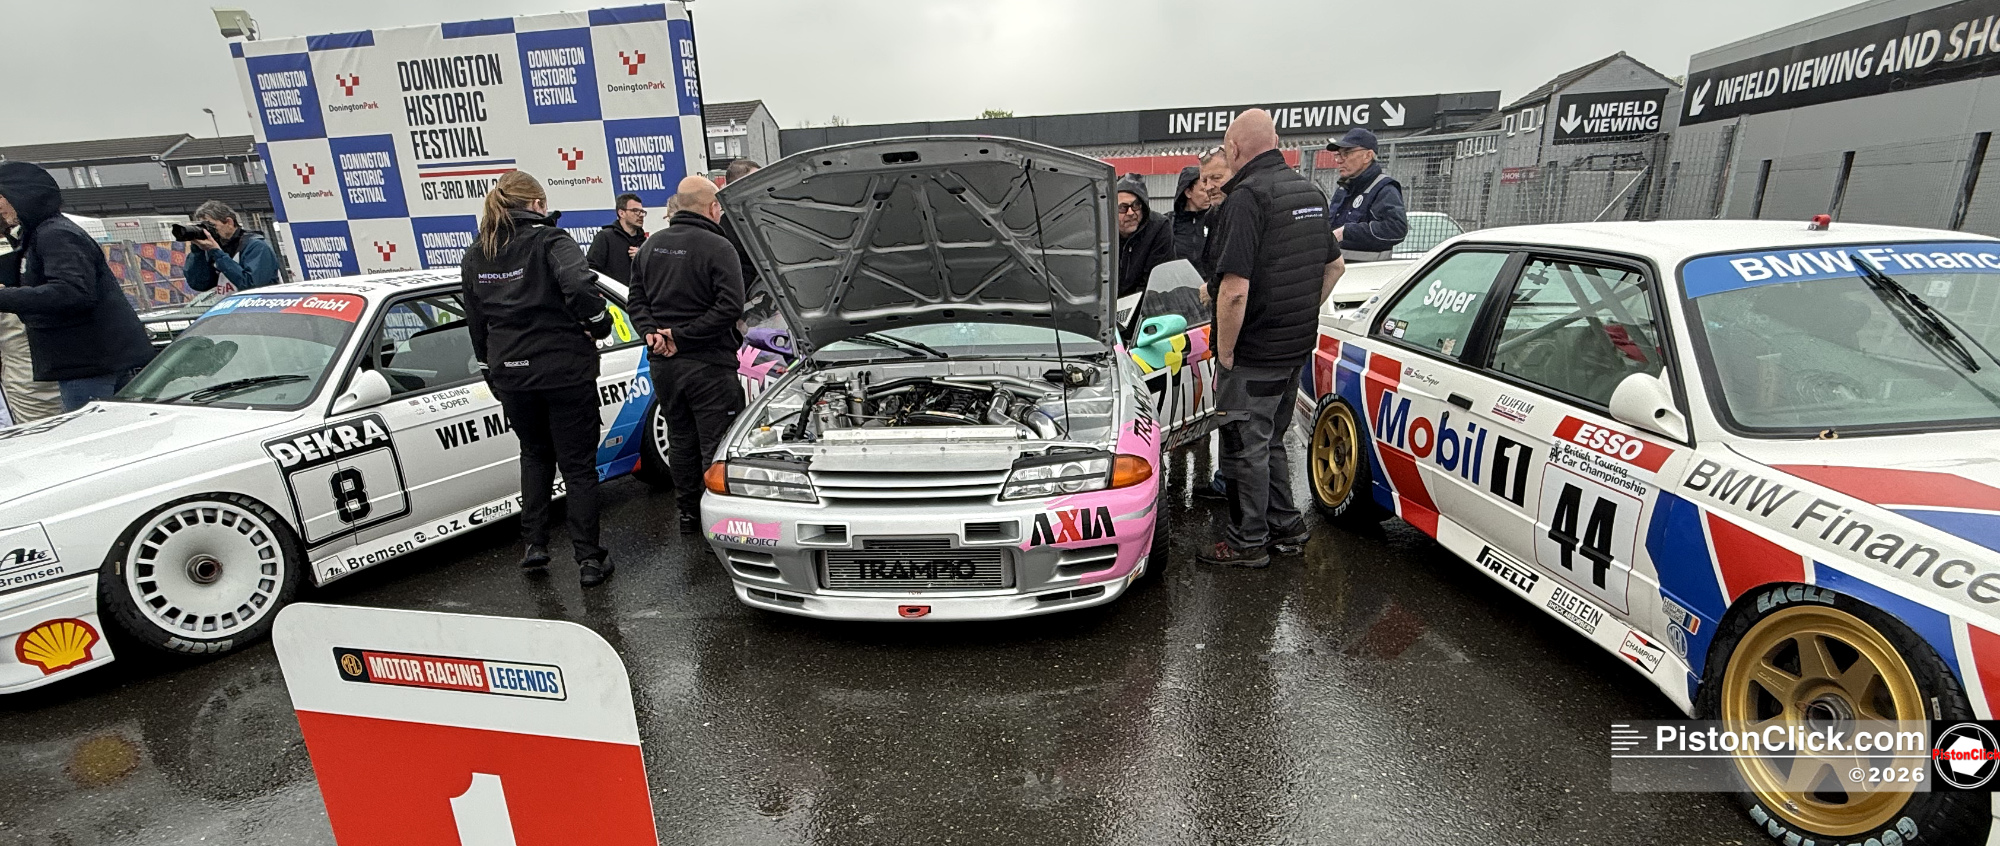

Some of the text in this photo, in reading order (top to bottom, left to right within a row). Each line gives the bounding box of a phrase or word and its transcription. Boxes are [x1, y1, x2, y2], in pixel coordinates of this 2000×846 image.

[527, 47, 586, 68] DONINGTON
[1714, 67, 1779, 107] INFIELD
[1782, 43, 1876, 94] VIEWING
[1875, 29, 1941, 76] AND
[256, 70, 308, 90] DONINGTON
[397, 53, 503, 92] DONINGTON
[530, 67, 577, 88] HISTORIC
[533, 87, 577, 106] FESTIVAL
[607, 81, 666, 93] DoningtonPark
[261, 90, 302, 108] HISTORIC
[328, 101, 379, 113] DoningtonPark
[403, 91, 488, 126] HISTORIC
[1588, 100, 1658, 118] INFIELD
[266, 107, 305, 125] FESTIVAL
[1168, 103, 1370, 134] INFIE VIEWING
[1582, 115, 1659, 133] VIEWING
[410, 126, 490, 160] FESTIVAL
[614, 135, 675, 155] DONINGTON
[339, 152, 392, 170] DONINGTON
[618, 154, 665, 174] HISTORIC
[343, 169, 385, 187] HISTORIC
[547, 176, 604, 187] DoningtonPark
[620, 173, 666, 191] FESTIVAL
[347, 187, 387, 204] FESTIVAL
[420, 180, 464, 201] 1ST-3RD
[466, 178, 489, 198] MAY
[300, 236, 348, 253] DONINGTON
[422, 231, 474, 249] DONINGTON
[304, 253, 342, 269] HISTORIC
[1729, 250, 1857, 282] BMW
[235, 297, 303, 308] Motorsport
[302, 297, 351, 312] GmbH
[1423, 279, 1477, 314] Soper
[432, 387, 471, 402] FIELDING
[440, 397, 470, 410] SOPER
[1497, 393, 1535, 415] FUJIFILM
[268, 419, 390, 468] DEKRA
[435, 419, 480, 450] WIE
[1376, 390, 1522, 500] Mobil 1
[1573, 423, 1644, 461] ESSO
[1564, 444, 1629, 478] British Touring
[1562, 454, 1647, 496] Car Championship
[328, 465, 374, 526] 8
[347, 540, 414, 571] Bremsen
[469, 500, 512, 526] Eibach
[727, 520, 755, 536] AXIA
[1029, 506, 1117, 547] AXIA
[1548, 481, 1618, 591] 44
[1683, 458, 2000, 605] BMW Finance
[708, 532, 779, 547] RACING PROJECT
[0, 565, 64, 588] Bremsen
[855, 560, 976, 580] TRAMPO
[1476, 545, 1540, 594] PIRELLI
[1551, 587, 1604, 627] BILSTEIN
[1757, 584, 1836, 614] EAGLE
[1625, 640, 1658, 664] CHAMPION
[368, 656, 425, 682] MOTOR
[423, 660, 483, 687] RACING
[488, 666, 559, 694] LEGENDS
[449, 772, 517, 846] 1
